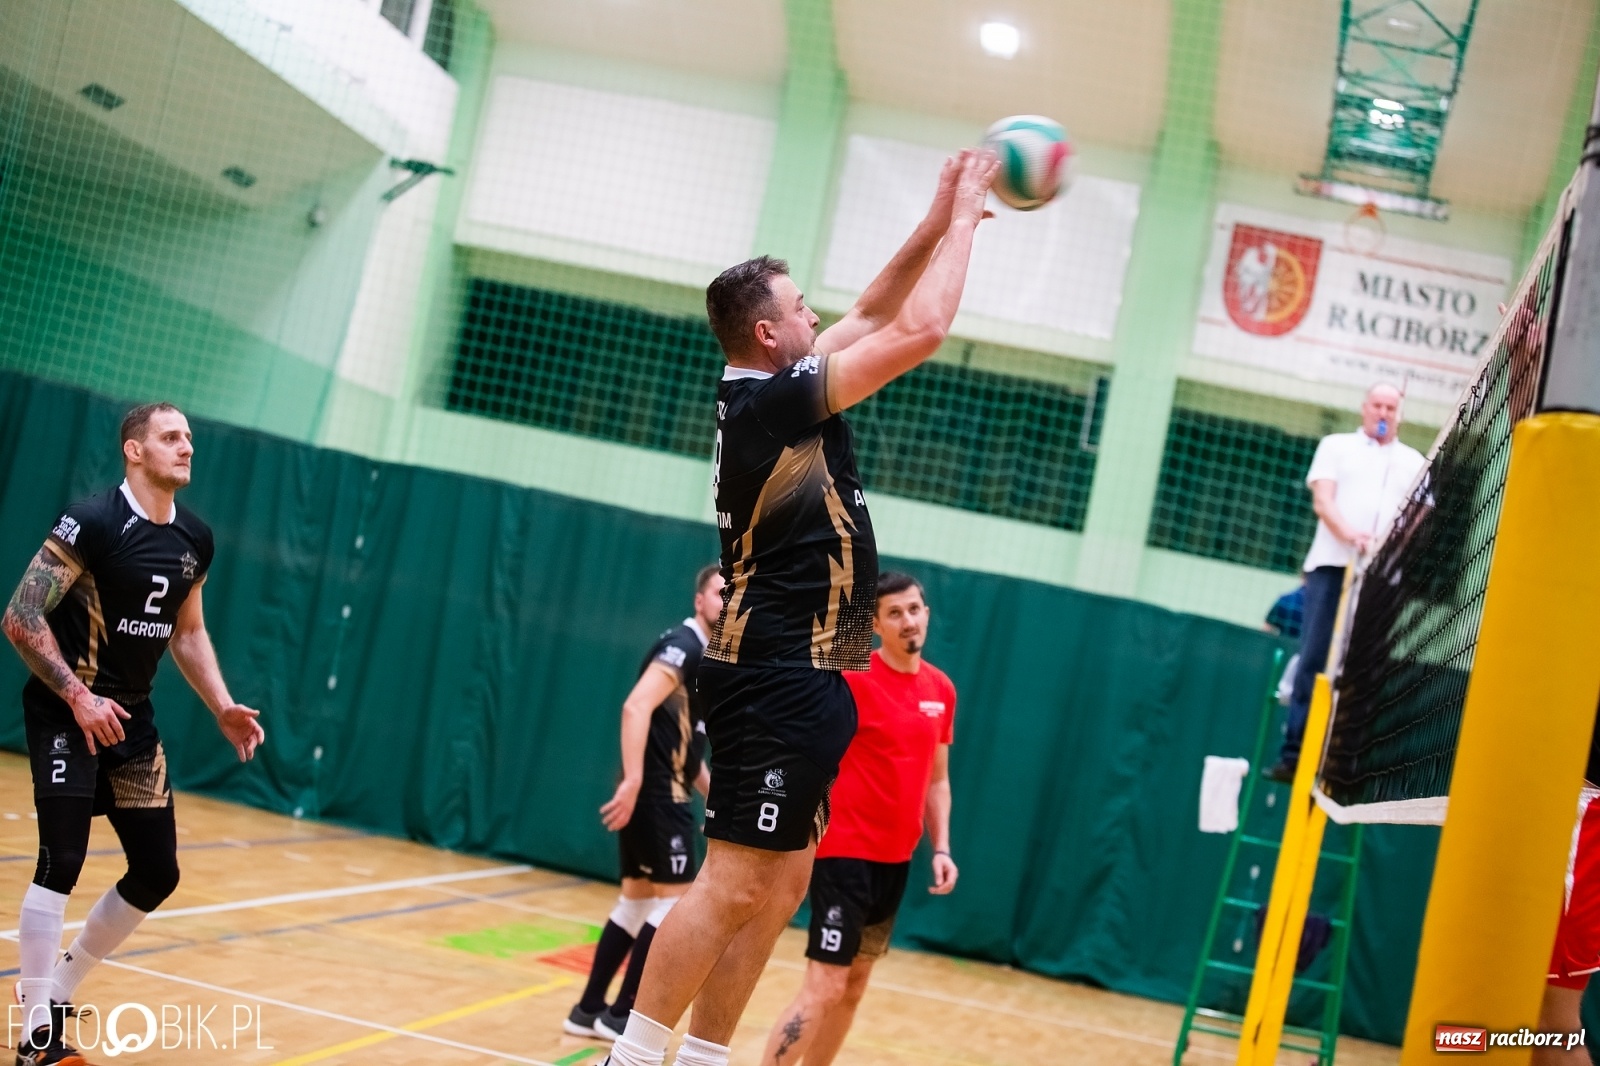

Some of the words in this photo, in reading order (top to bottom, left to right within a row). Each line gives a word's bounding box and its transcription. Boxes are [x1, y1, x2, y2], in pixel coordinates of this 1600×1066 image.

[1357, 270, 1477, 318] MIASTO
[1328, 303, 1491, 356] RACIBÓRZ
[144, 574, 169, 615] 2
[117, 618, 173, 639] AGROTIM
[51, 759, 67, 784] 2
[757, 802, 780, 833] 8
[669, 854, 688, 875] 17
[820, 928, 842, 952] 19
